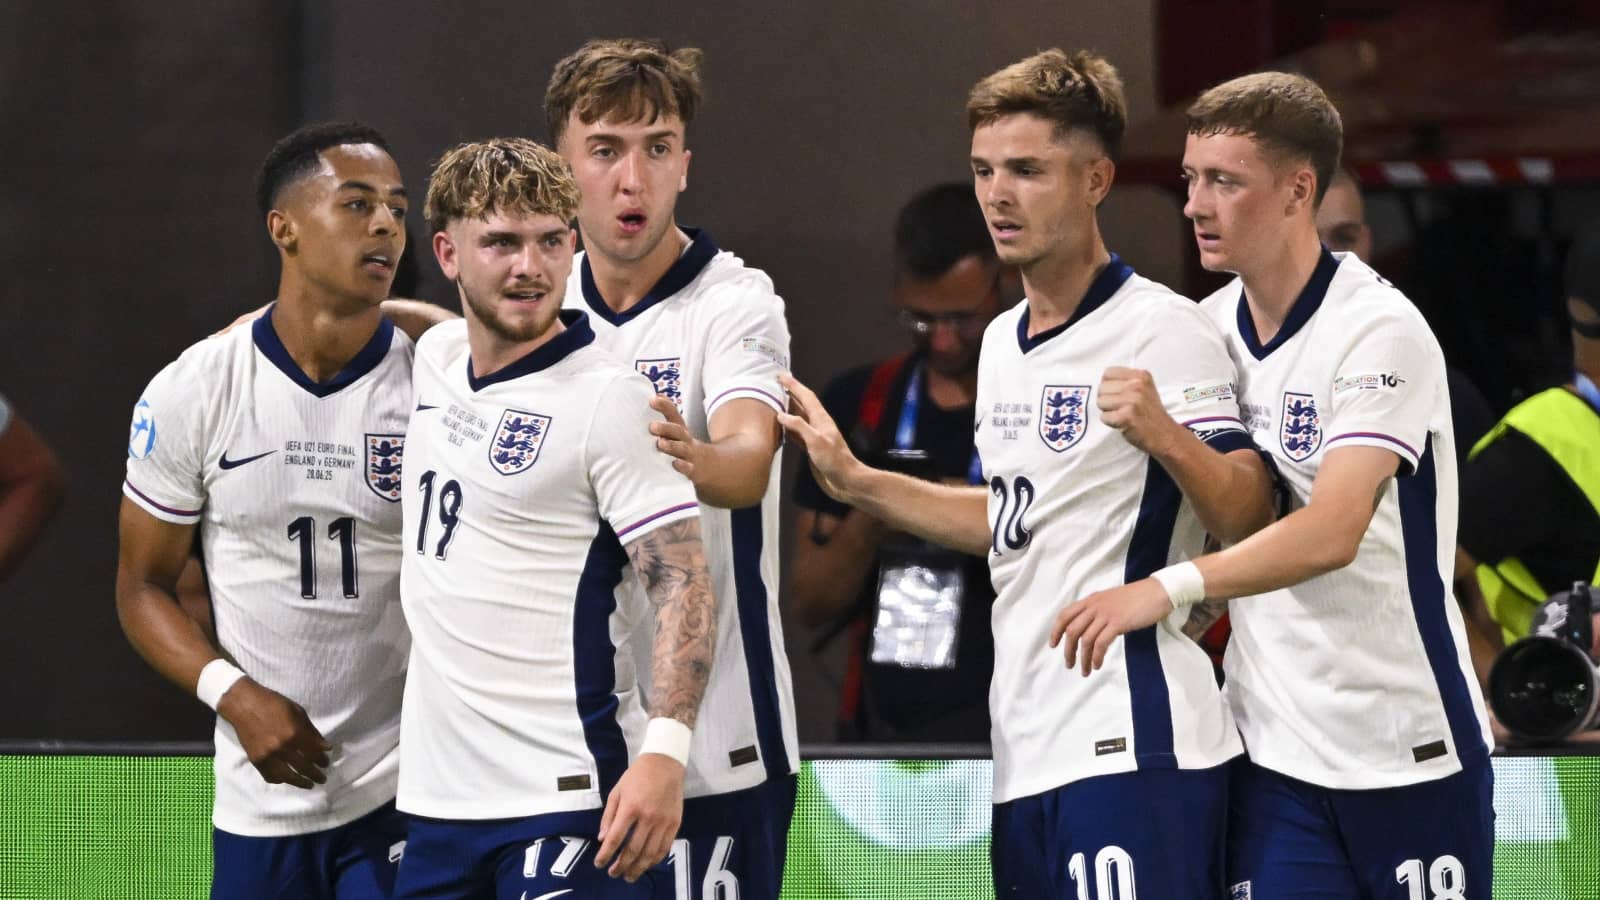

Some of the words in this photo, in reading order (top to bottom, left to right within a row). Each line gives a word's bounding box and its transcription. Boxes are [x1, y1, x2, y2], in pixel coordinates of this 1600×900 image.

[284, 454, 315, 466] ENGLAND
[324, 456, 355, 469] GERMANY
[285, 440, 301, 451] UEFA
[304, 441, 315, 452] U21
[317, 442, 335, 453] EURO
[337, 444, 355, 456] FINAL
[417, 470, 463, 561] 19
[991, 476, 1034, 556] 10
[287, 516, 359, 599] 11
[667, 836, 741, 900] 16
[1068, 845, 1137, 900] 10
[1395, 855, 1467, 900] 18
